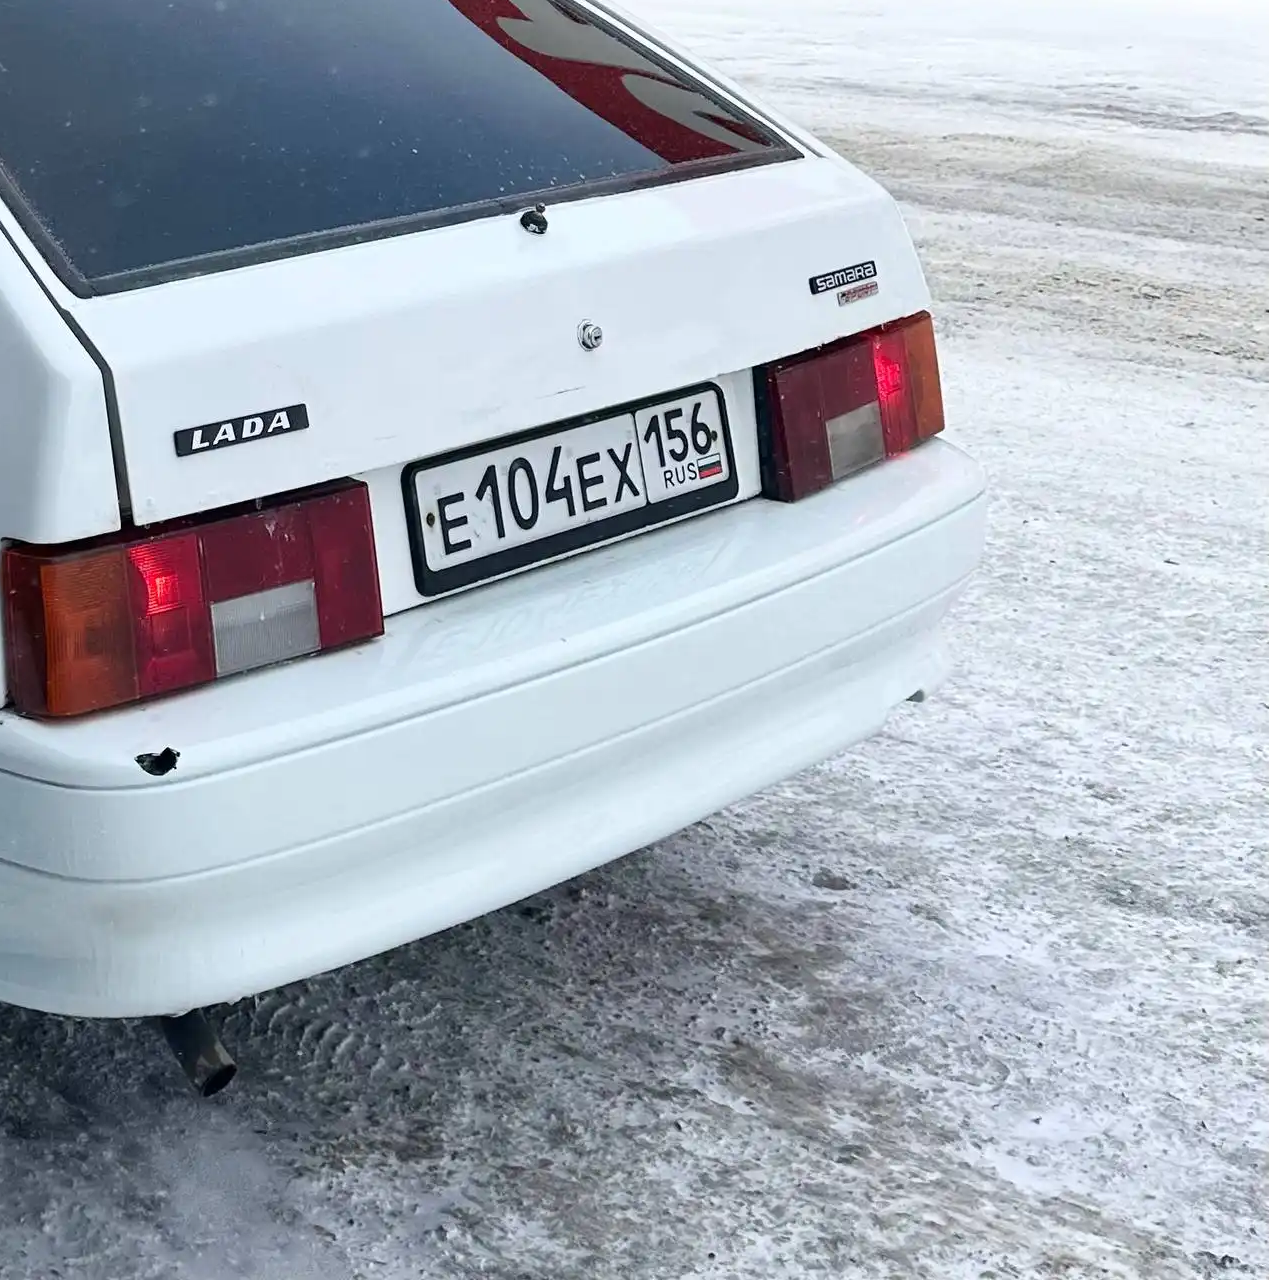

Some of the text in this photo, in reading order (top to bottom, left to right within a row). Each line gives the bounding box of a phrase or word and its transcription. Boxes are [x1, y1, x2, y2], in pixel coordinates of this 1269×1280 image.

[191, 411, 291, 450] LADA
[643, 402, 713, 468] 156
[663, 465, 698, 489] RUS
